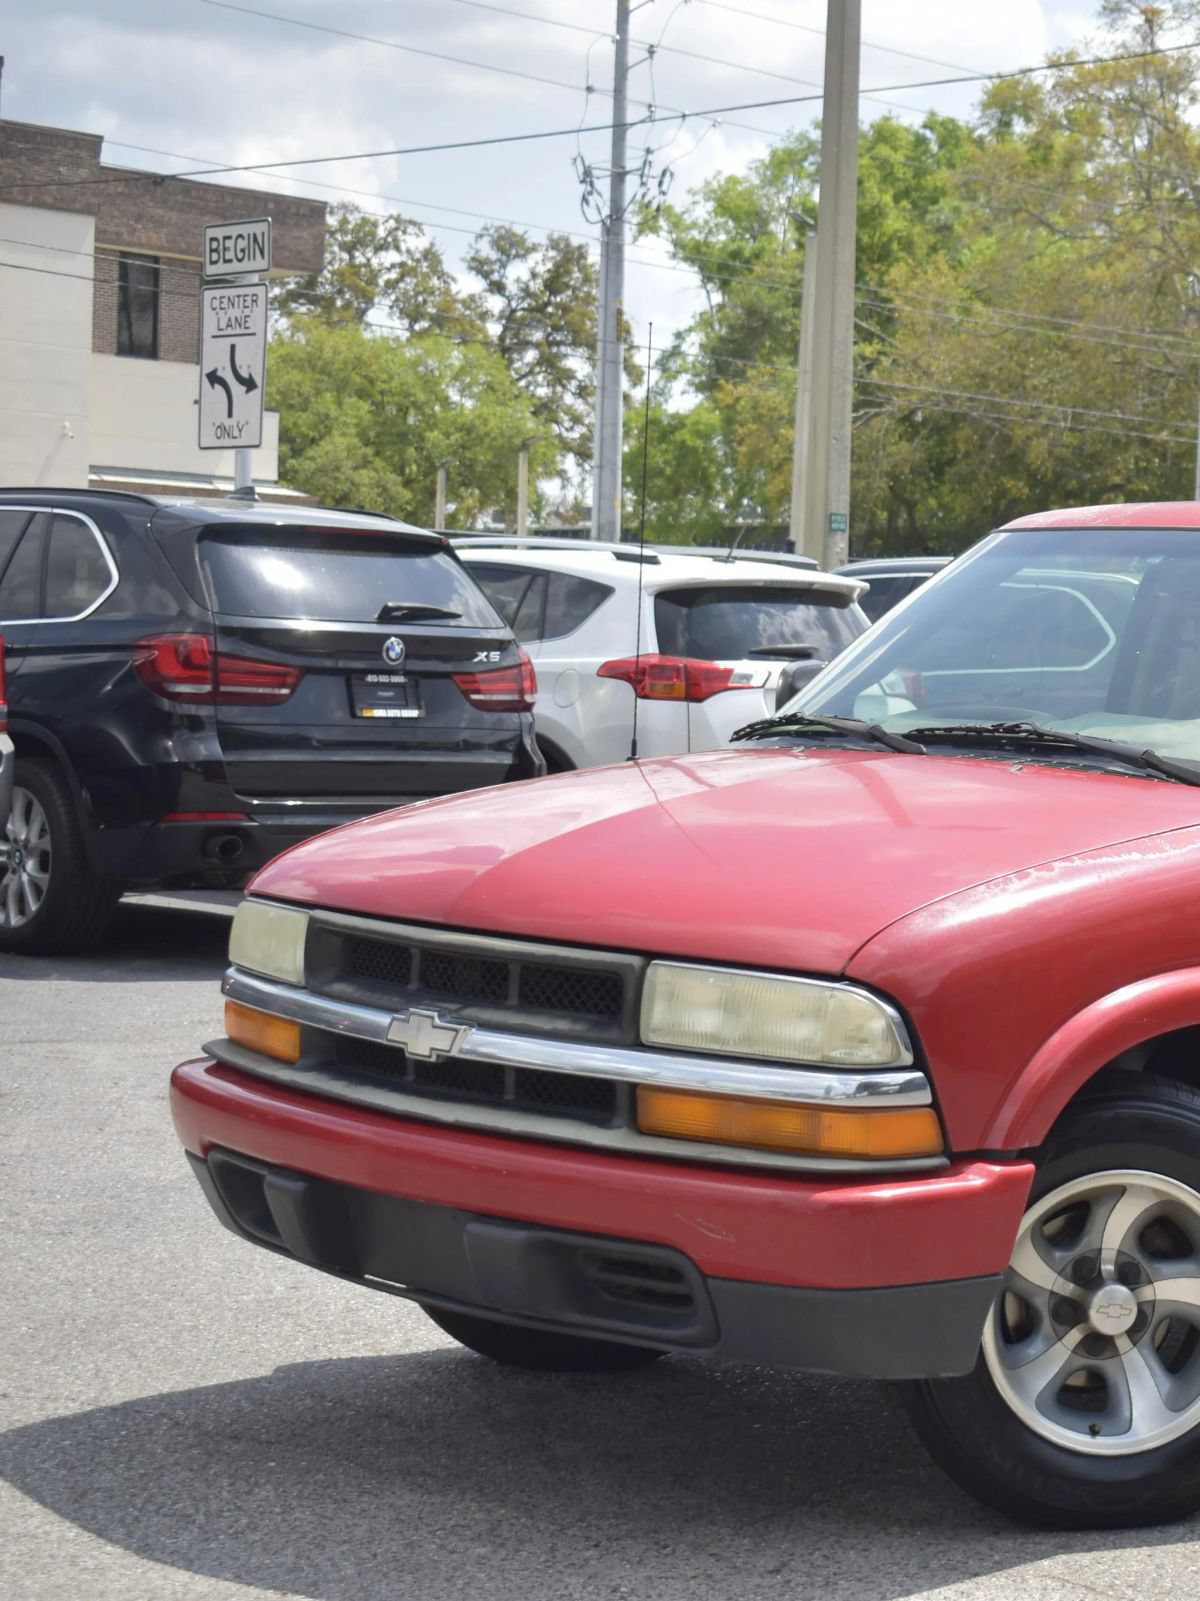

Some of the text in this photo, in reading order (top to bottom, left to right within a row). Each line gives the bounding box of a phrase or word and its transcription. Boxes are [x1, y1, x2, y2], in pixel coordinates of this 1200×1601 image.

[209, 231, 265, 266] BEGIN
[210, 293, 259, 312] CENTER
[217, 314, 251, 332] LANE
[215, 424, 245, 440] ONLY
[472, 651, 501, 662] X5
